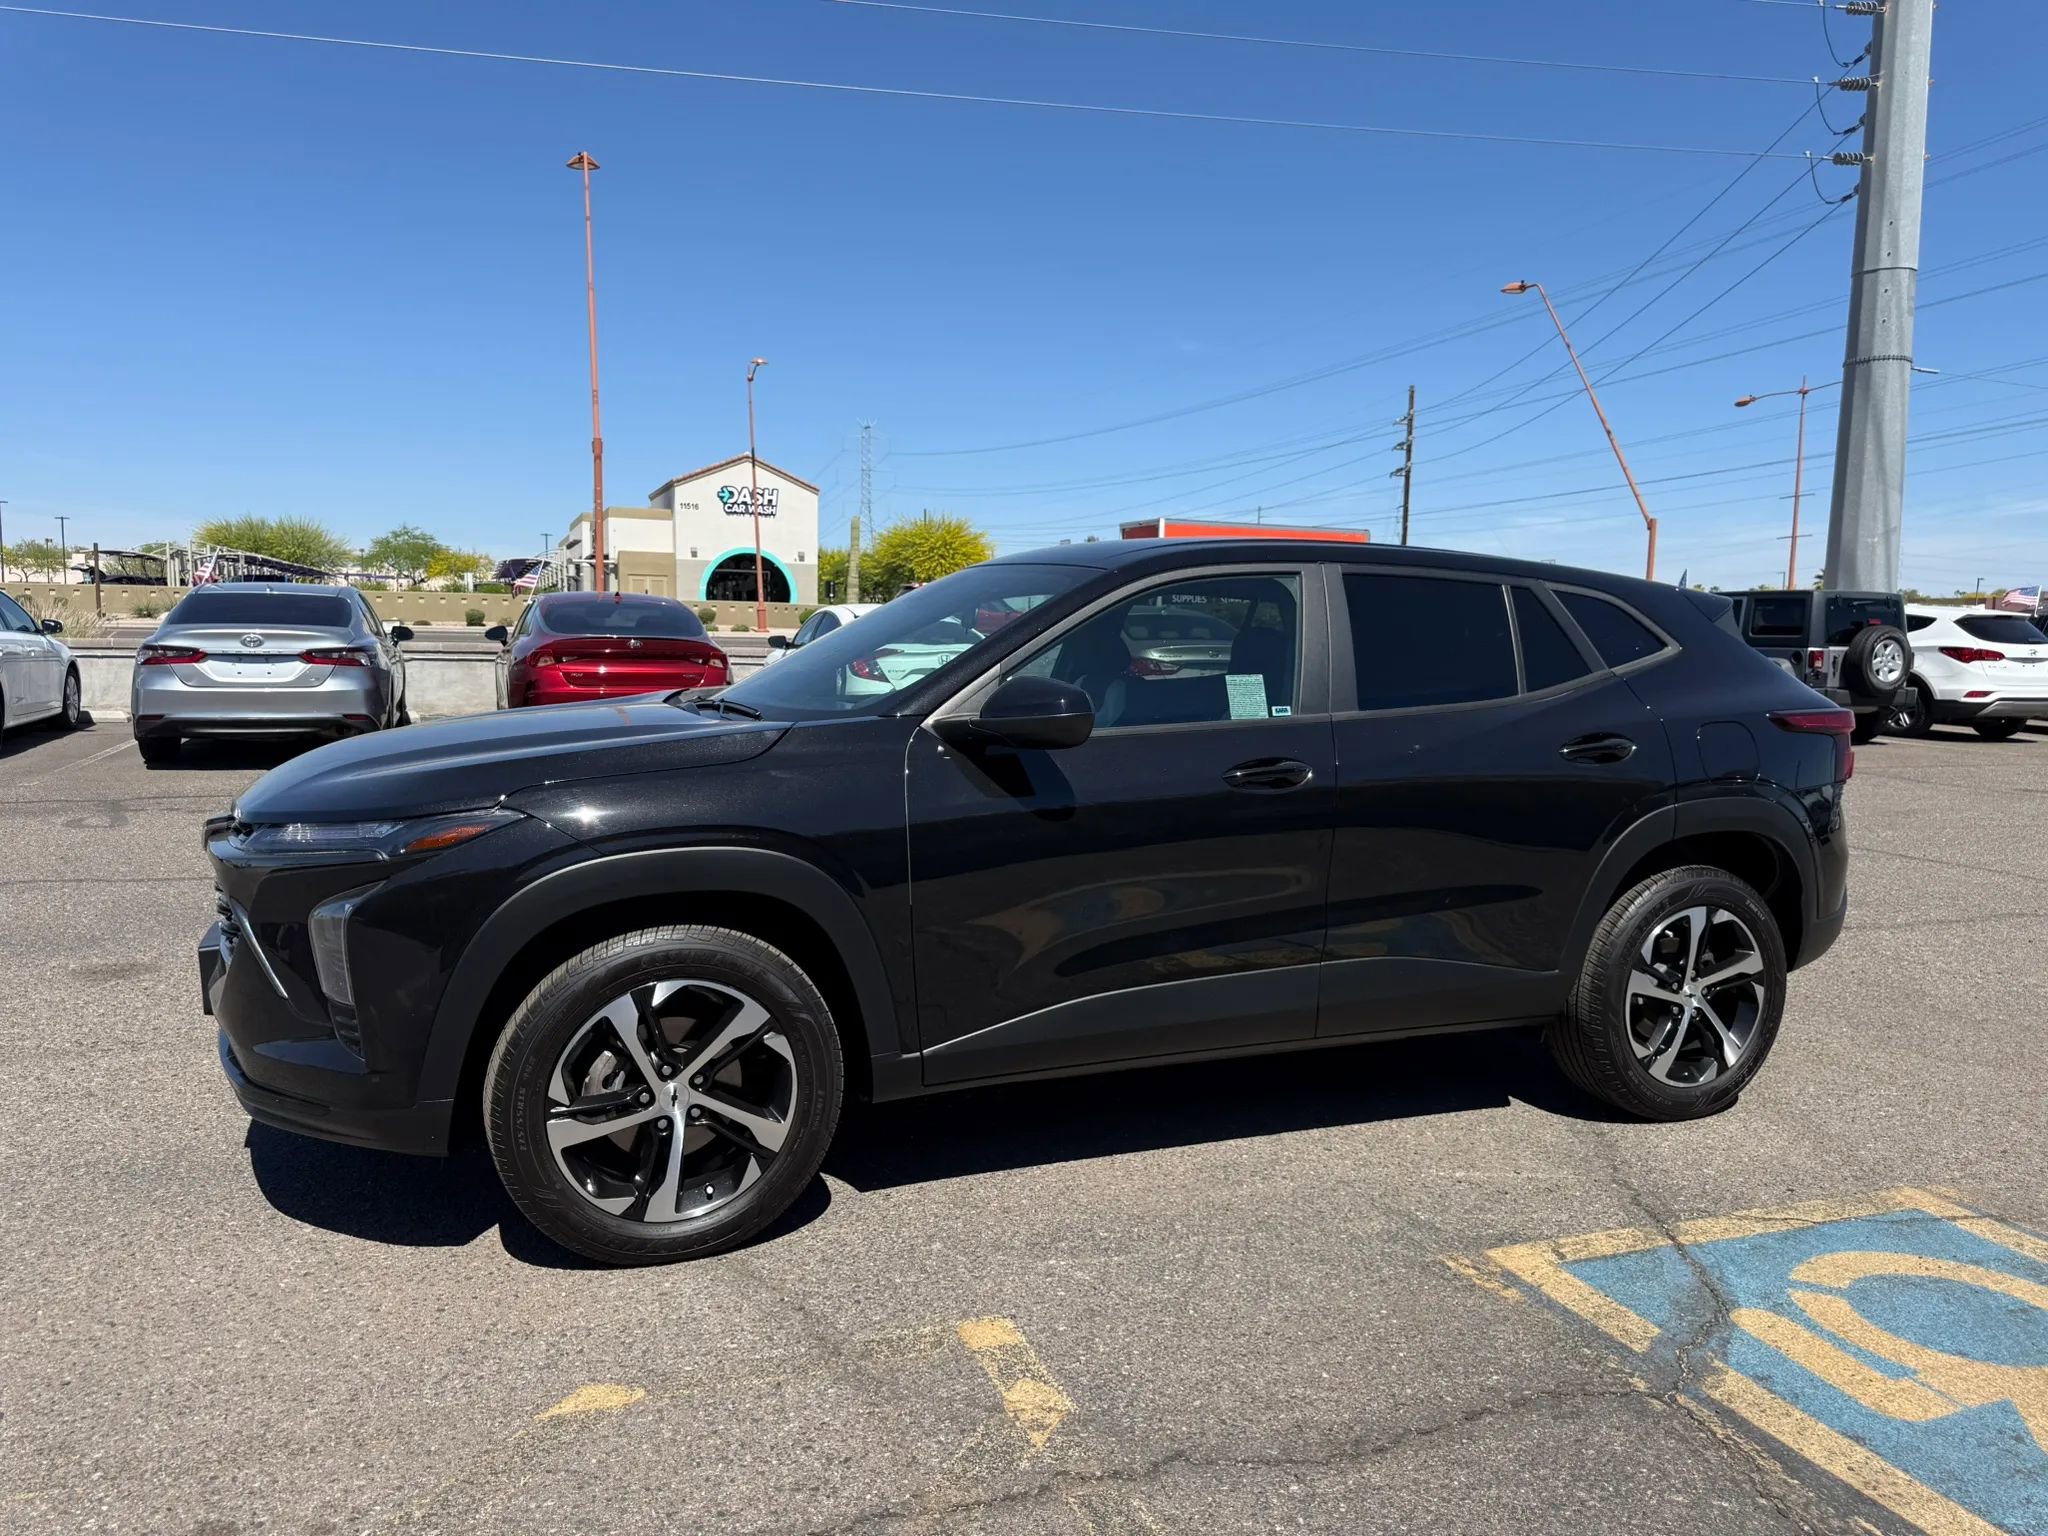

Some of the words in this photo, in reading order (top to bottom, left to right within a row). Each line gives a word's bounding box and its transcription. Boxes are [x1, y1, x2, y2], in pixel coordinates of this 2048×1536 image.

[720, 486, 778, 506] DASH
[680, 502, 699, 510] 11516
[724, 503, 746, 513] CAR
